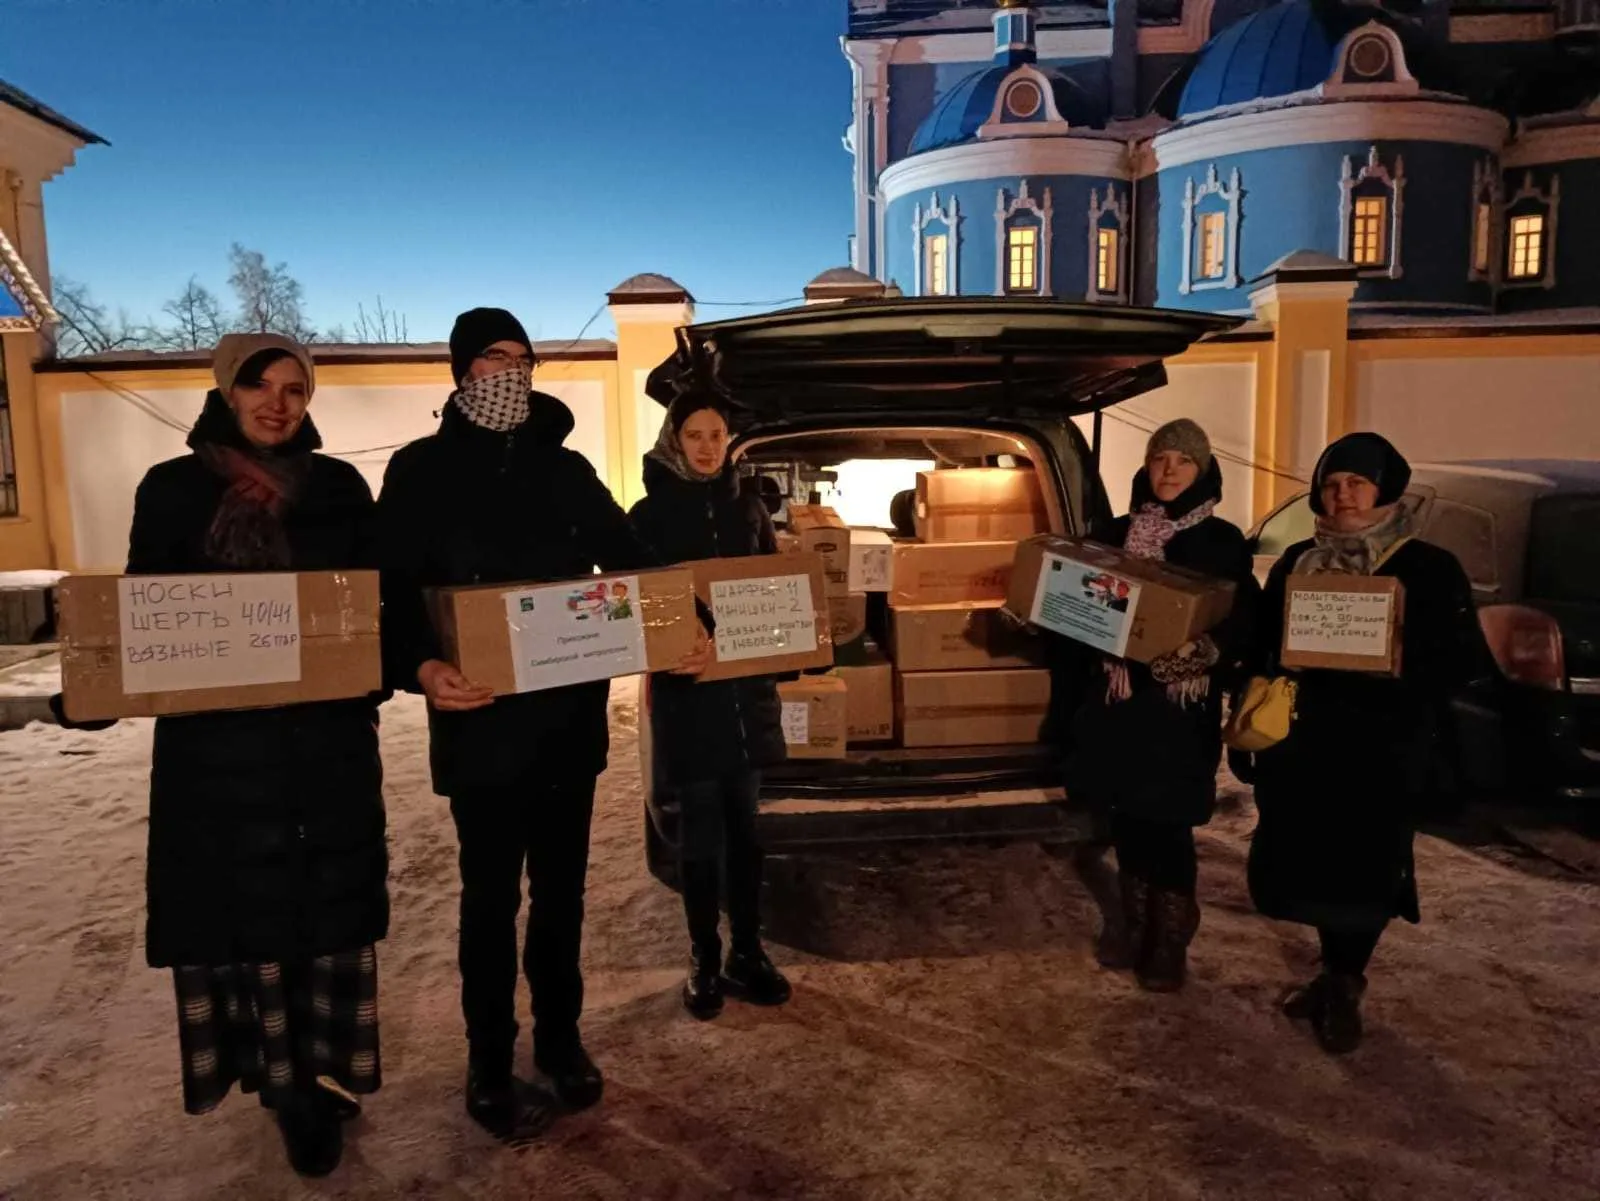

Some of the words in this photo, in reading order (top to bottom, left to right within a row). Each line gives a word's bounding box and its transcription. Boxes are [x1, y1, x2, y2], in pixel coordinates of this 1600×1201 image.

[130, 582, 233, 605] НОСКИ
[241, 600, 292, 626] 40/41
[126, 641, 232, 664] ВЯЗАНЫЕ
